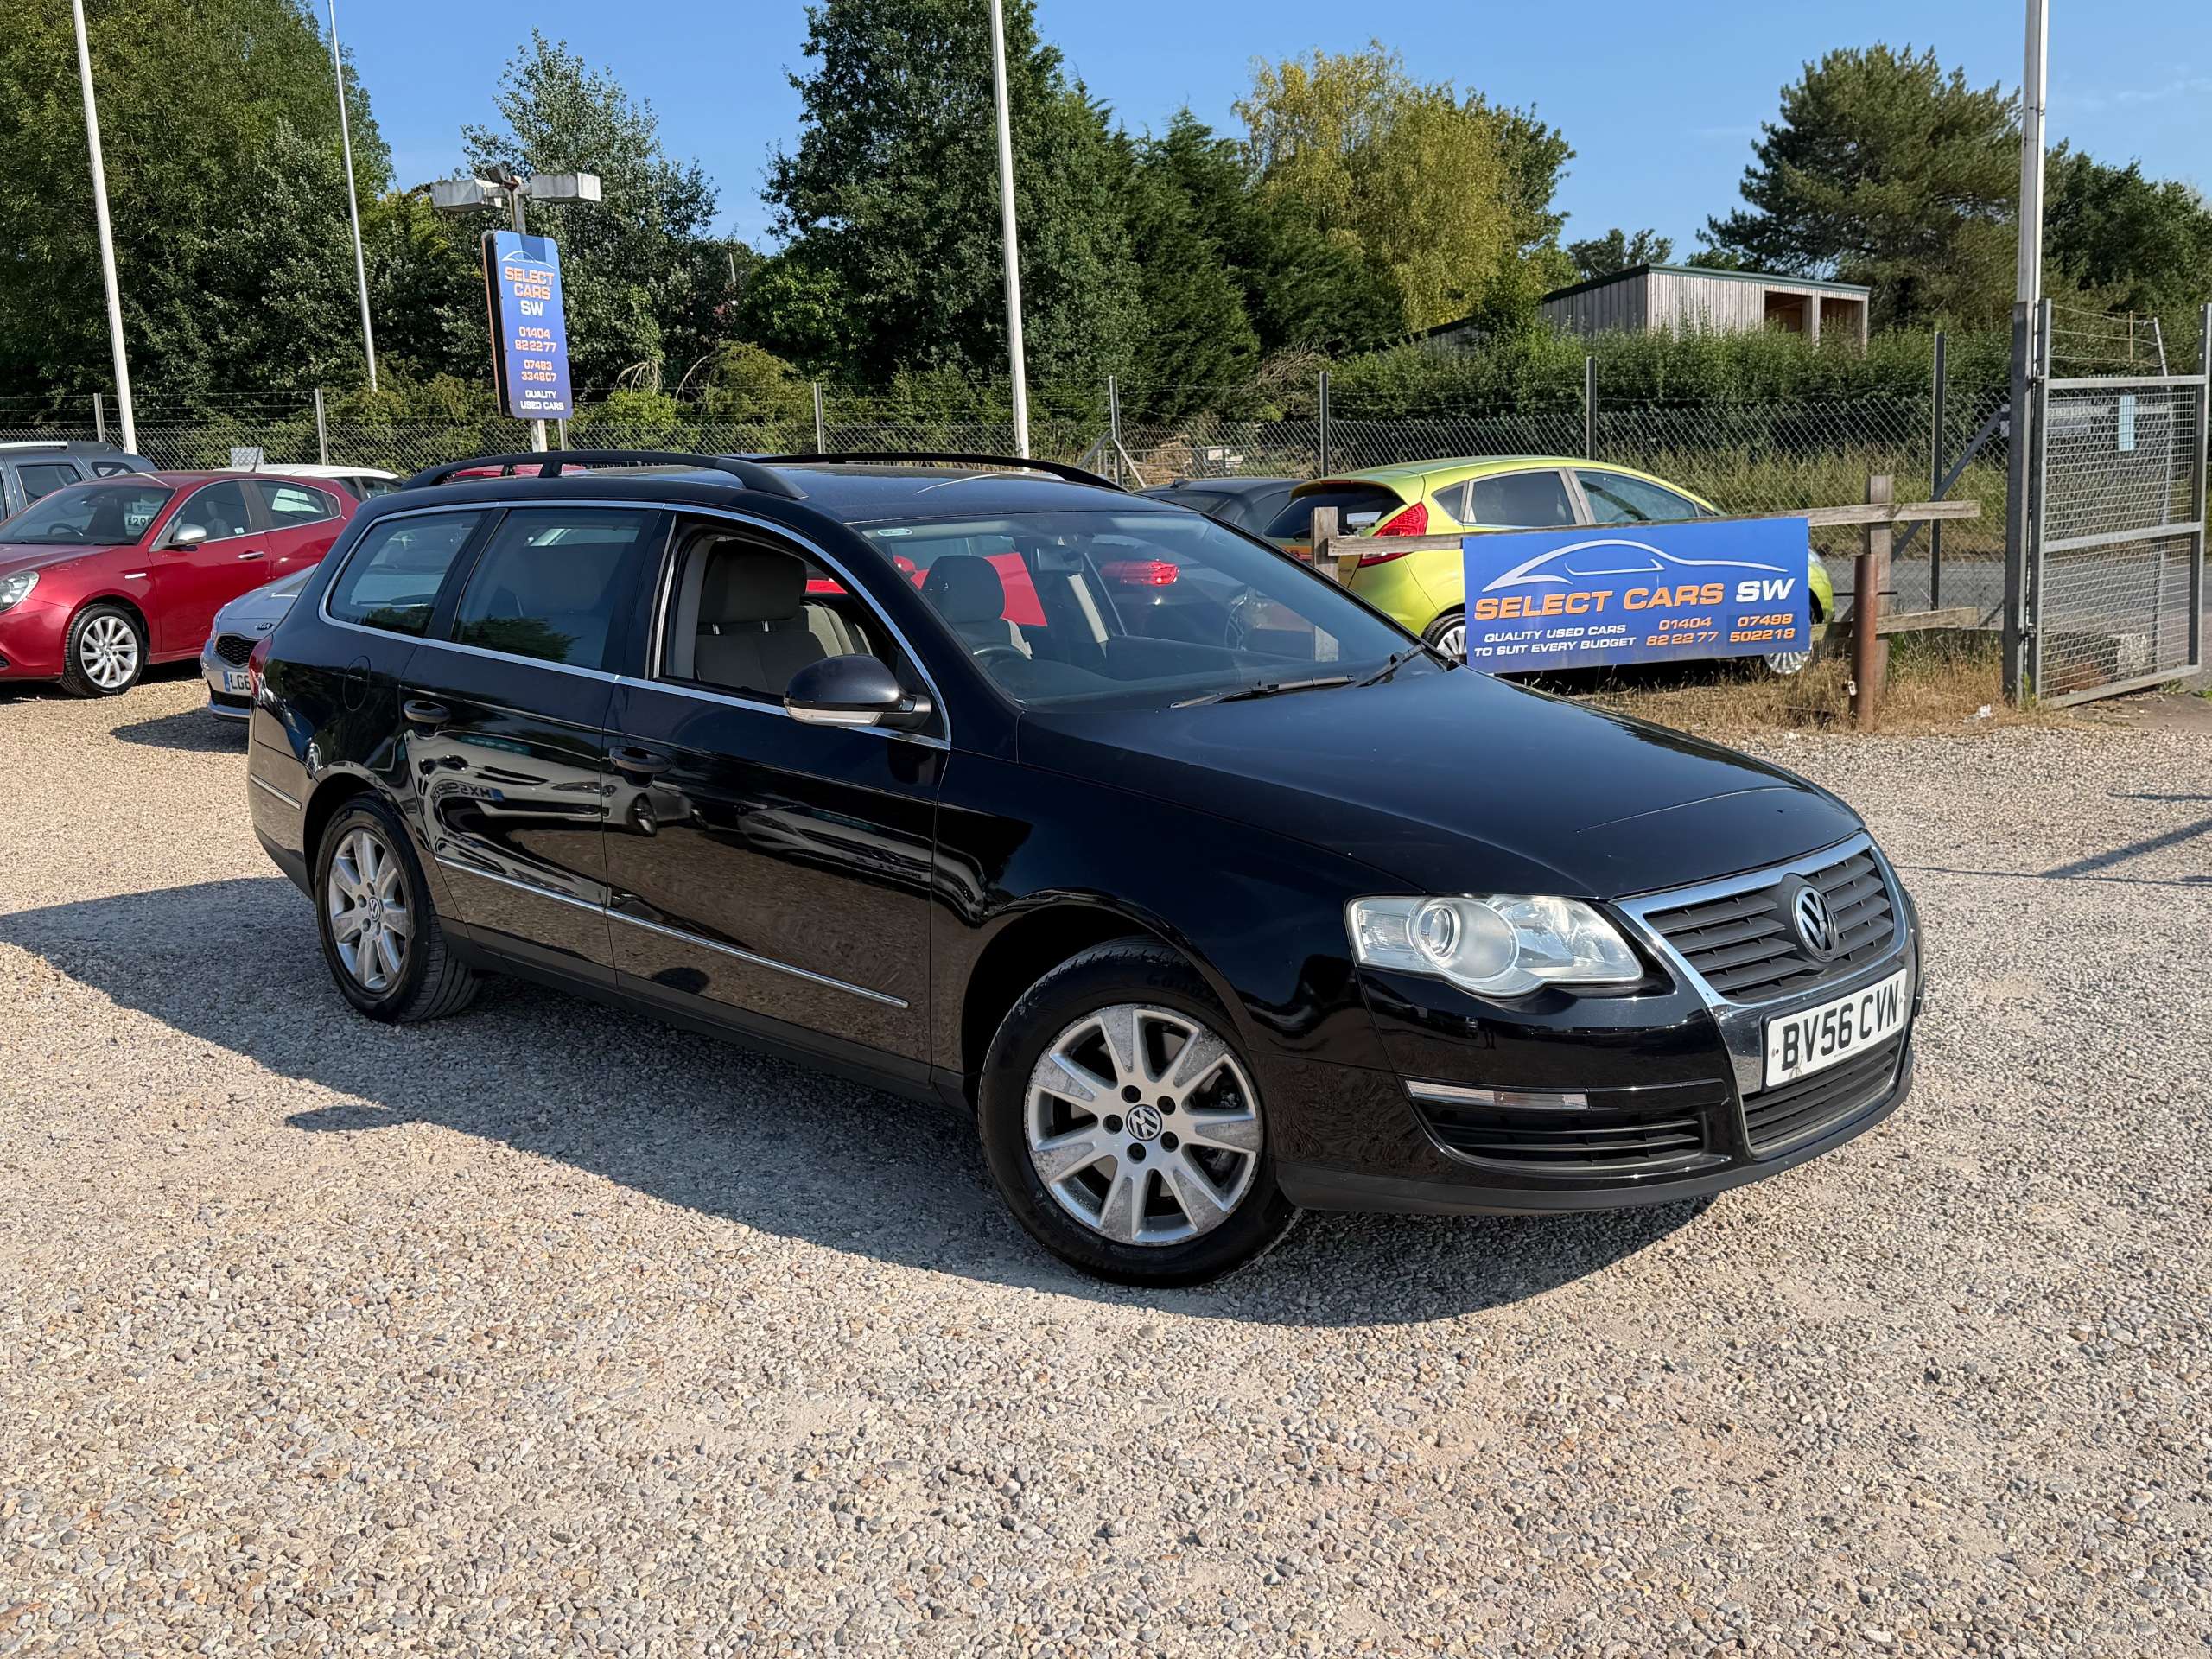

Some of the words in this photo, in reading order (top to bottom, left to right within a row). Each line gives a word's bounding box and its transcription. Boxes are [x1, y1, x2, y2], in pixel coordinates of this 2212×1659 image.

[505, 266, 555, 286] SELECT
[514, 283, 551, 301] CARS
[520, 300, 543, 317] SW
[518, 326, 551, 340] 01404
[524, 389, 557, 399] QUALITY
[519, 400, 542, 410] USED
[543, 401, 564, 410] CARS
[1474, 591, 1614, 621] SELECT
[1623, 582, 1725, 610] CARS
[1735, 577, 1796, 603] SW
[1658, 616, 1713, 631] 01404
[1737, 613, 1795, 628] 07498
[1484, 630, 1543, 643] QUALITY
[1546, 627, 1585, 639] USED
[1587, 624, 1627, 636] CARS
[1729, 627, 1796, 643] 502218
[1474, 646, 1493, 657] TO
[1496, 645, 1529, 656] SUIT
[1530, 640, 1578, 653] EVERY
[1580, 637, 1637, 650] BUDGET
[1781, 1002, 1853, 1071] BV56
[1859, 979, 1900, 1040] CVN
